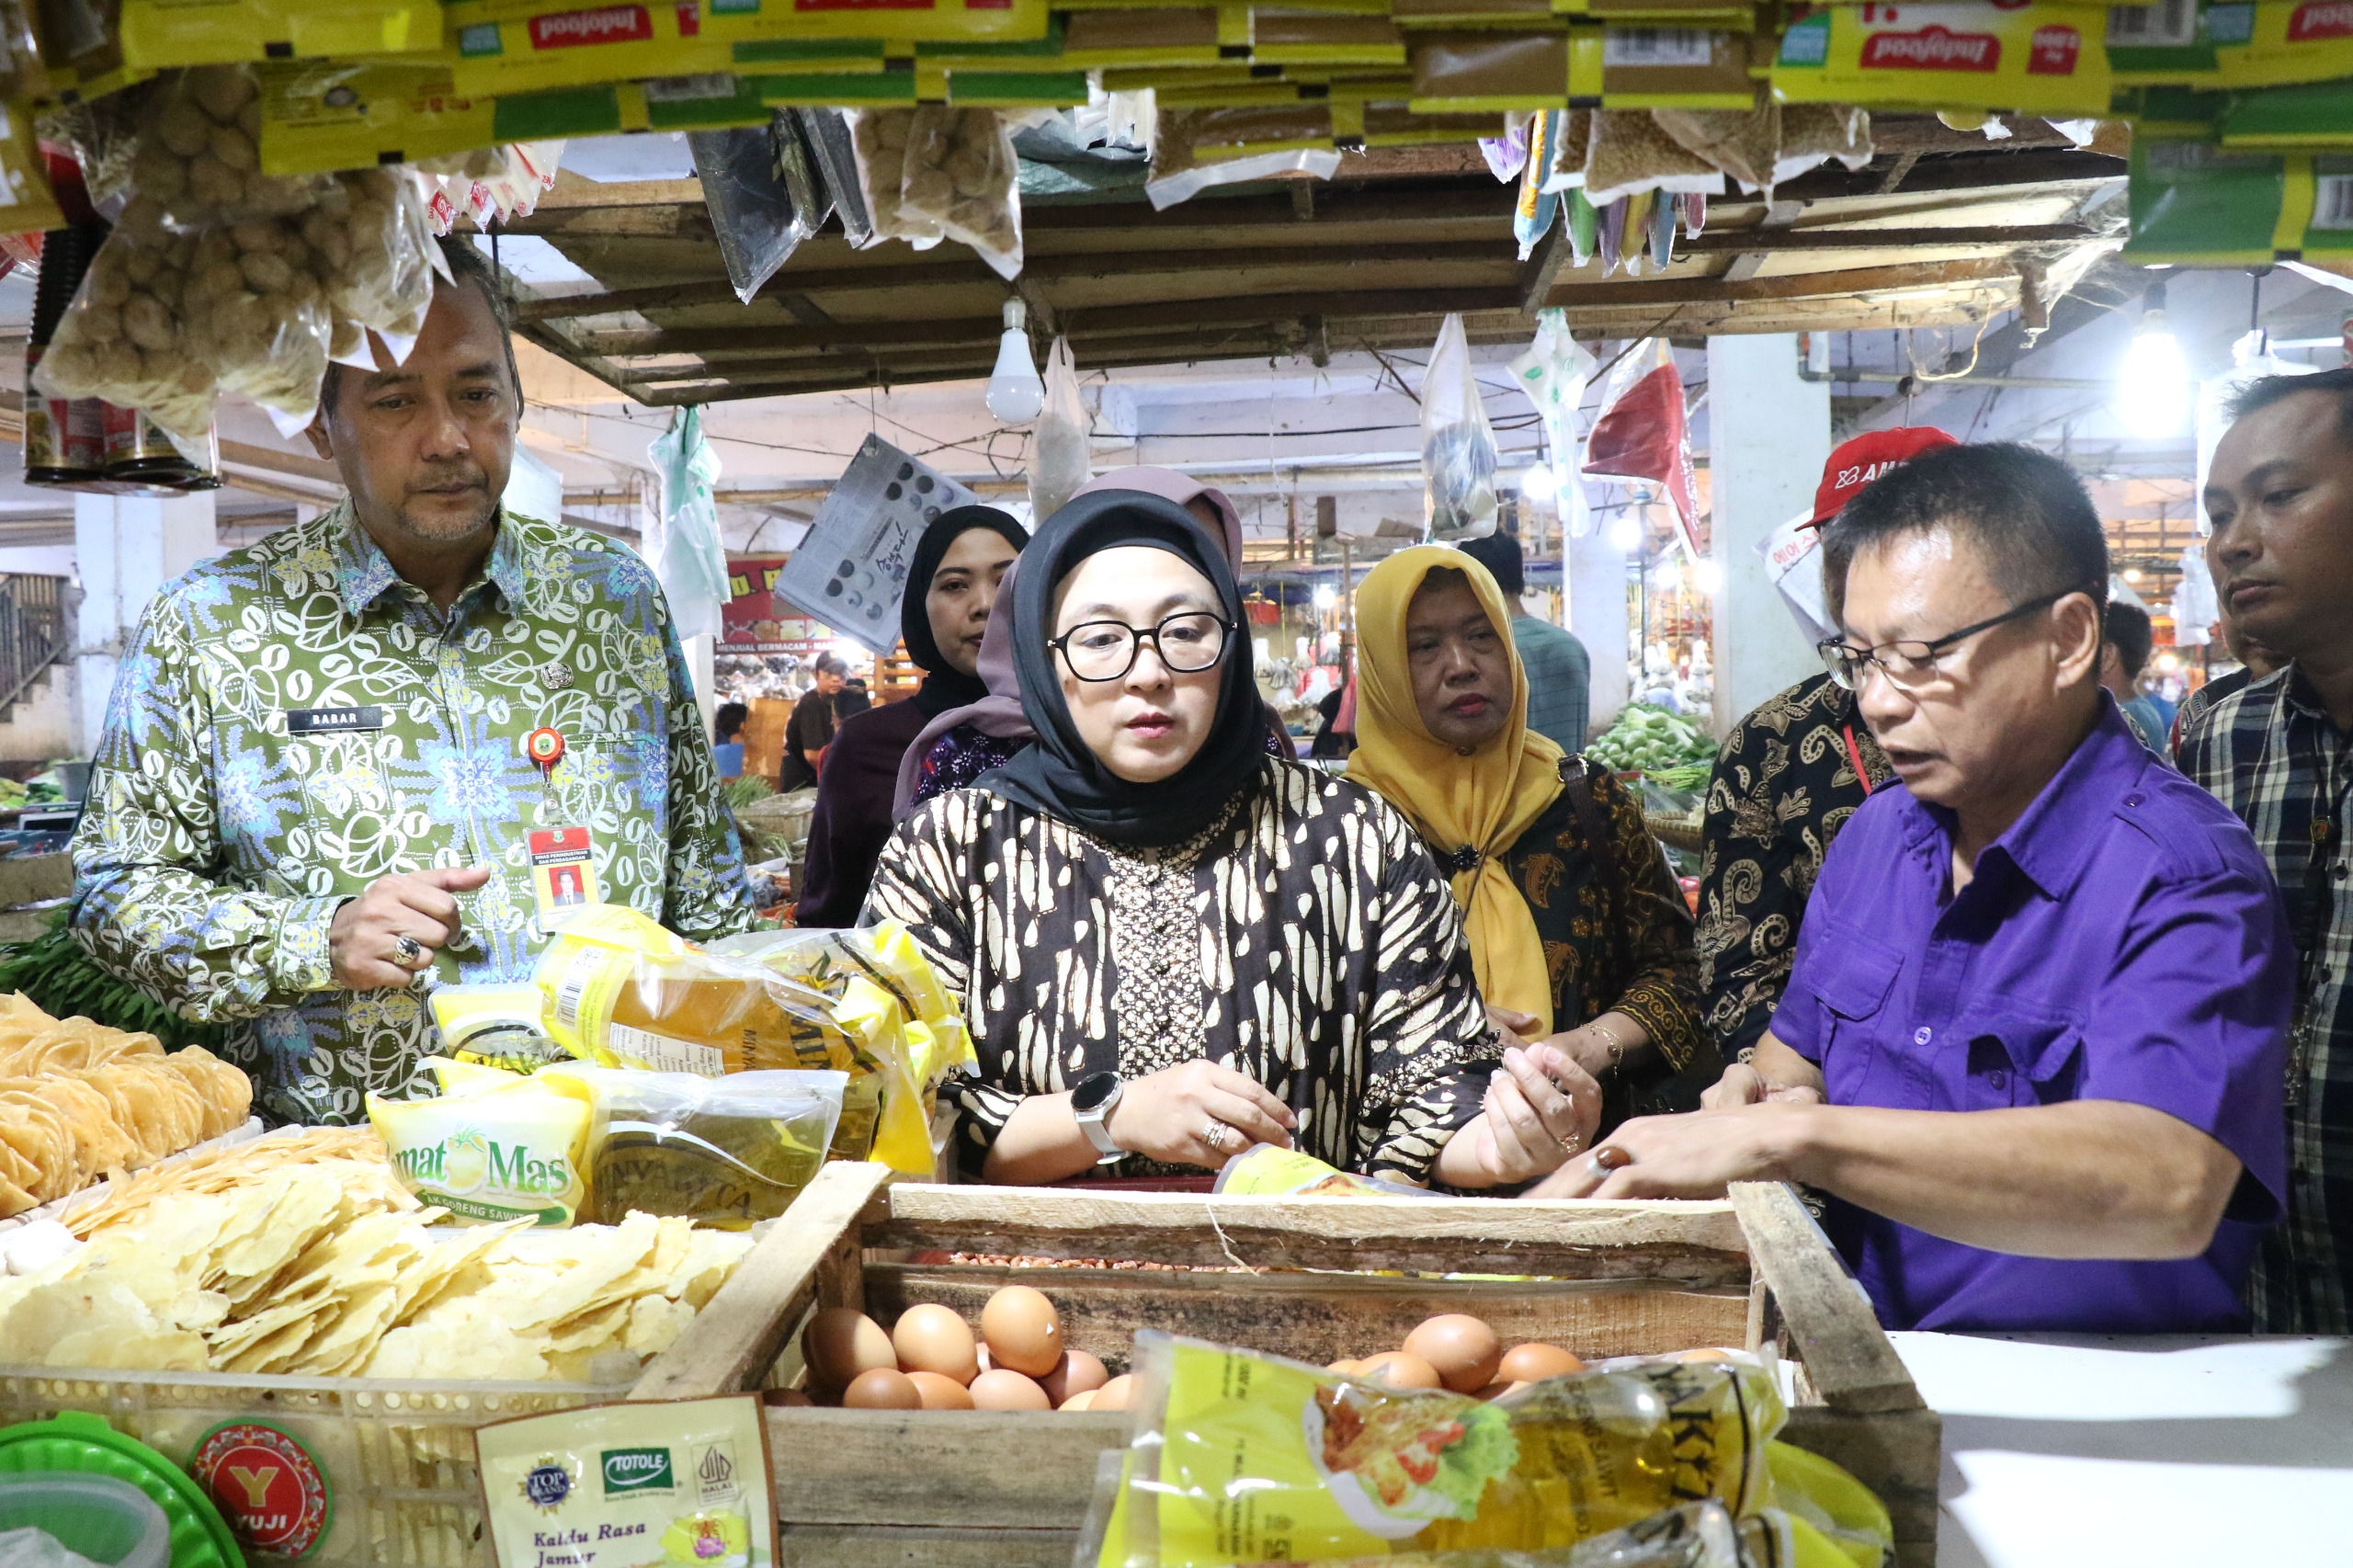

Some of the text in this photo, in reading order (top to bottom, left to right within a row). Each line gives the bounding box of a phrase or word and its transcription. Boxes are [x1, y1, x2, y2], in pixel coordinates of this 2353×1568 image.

[540, 8, 637, 40] Indofood
[1873, 34, 1987, 63] Indofood
[716, 644, 756, 653] MENJUAL
[758, 643, 807, 653] BERMACAM
[313, 713, 357, 727] BABAR
[550, 856, 586, 864] PERDAGANGAN
[551, 850, 588, 858] PERINDUSTRIAN
[742, 1029, 760, 1072] MINYA
[488, 1141, 572, 1194] Mas
[444, 1199, 487, 1217] GORENG
[490, 1210, 530, 1222] SAWIT
[615, 1453, 664, 1472] TOTOLE
[229, 1466, 279, 1507] Y
[529, 1471, 564, 1490] TOP
[701, 1481, 734, 1494] HALAL
[234, 1514, 287, 1530] YUJI
[533, 1522, 646, 1548] Kaldu Rasa
